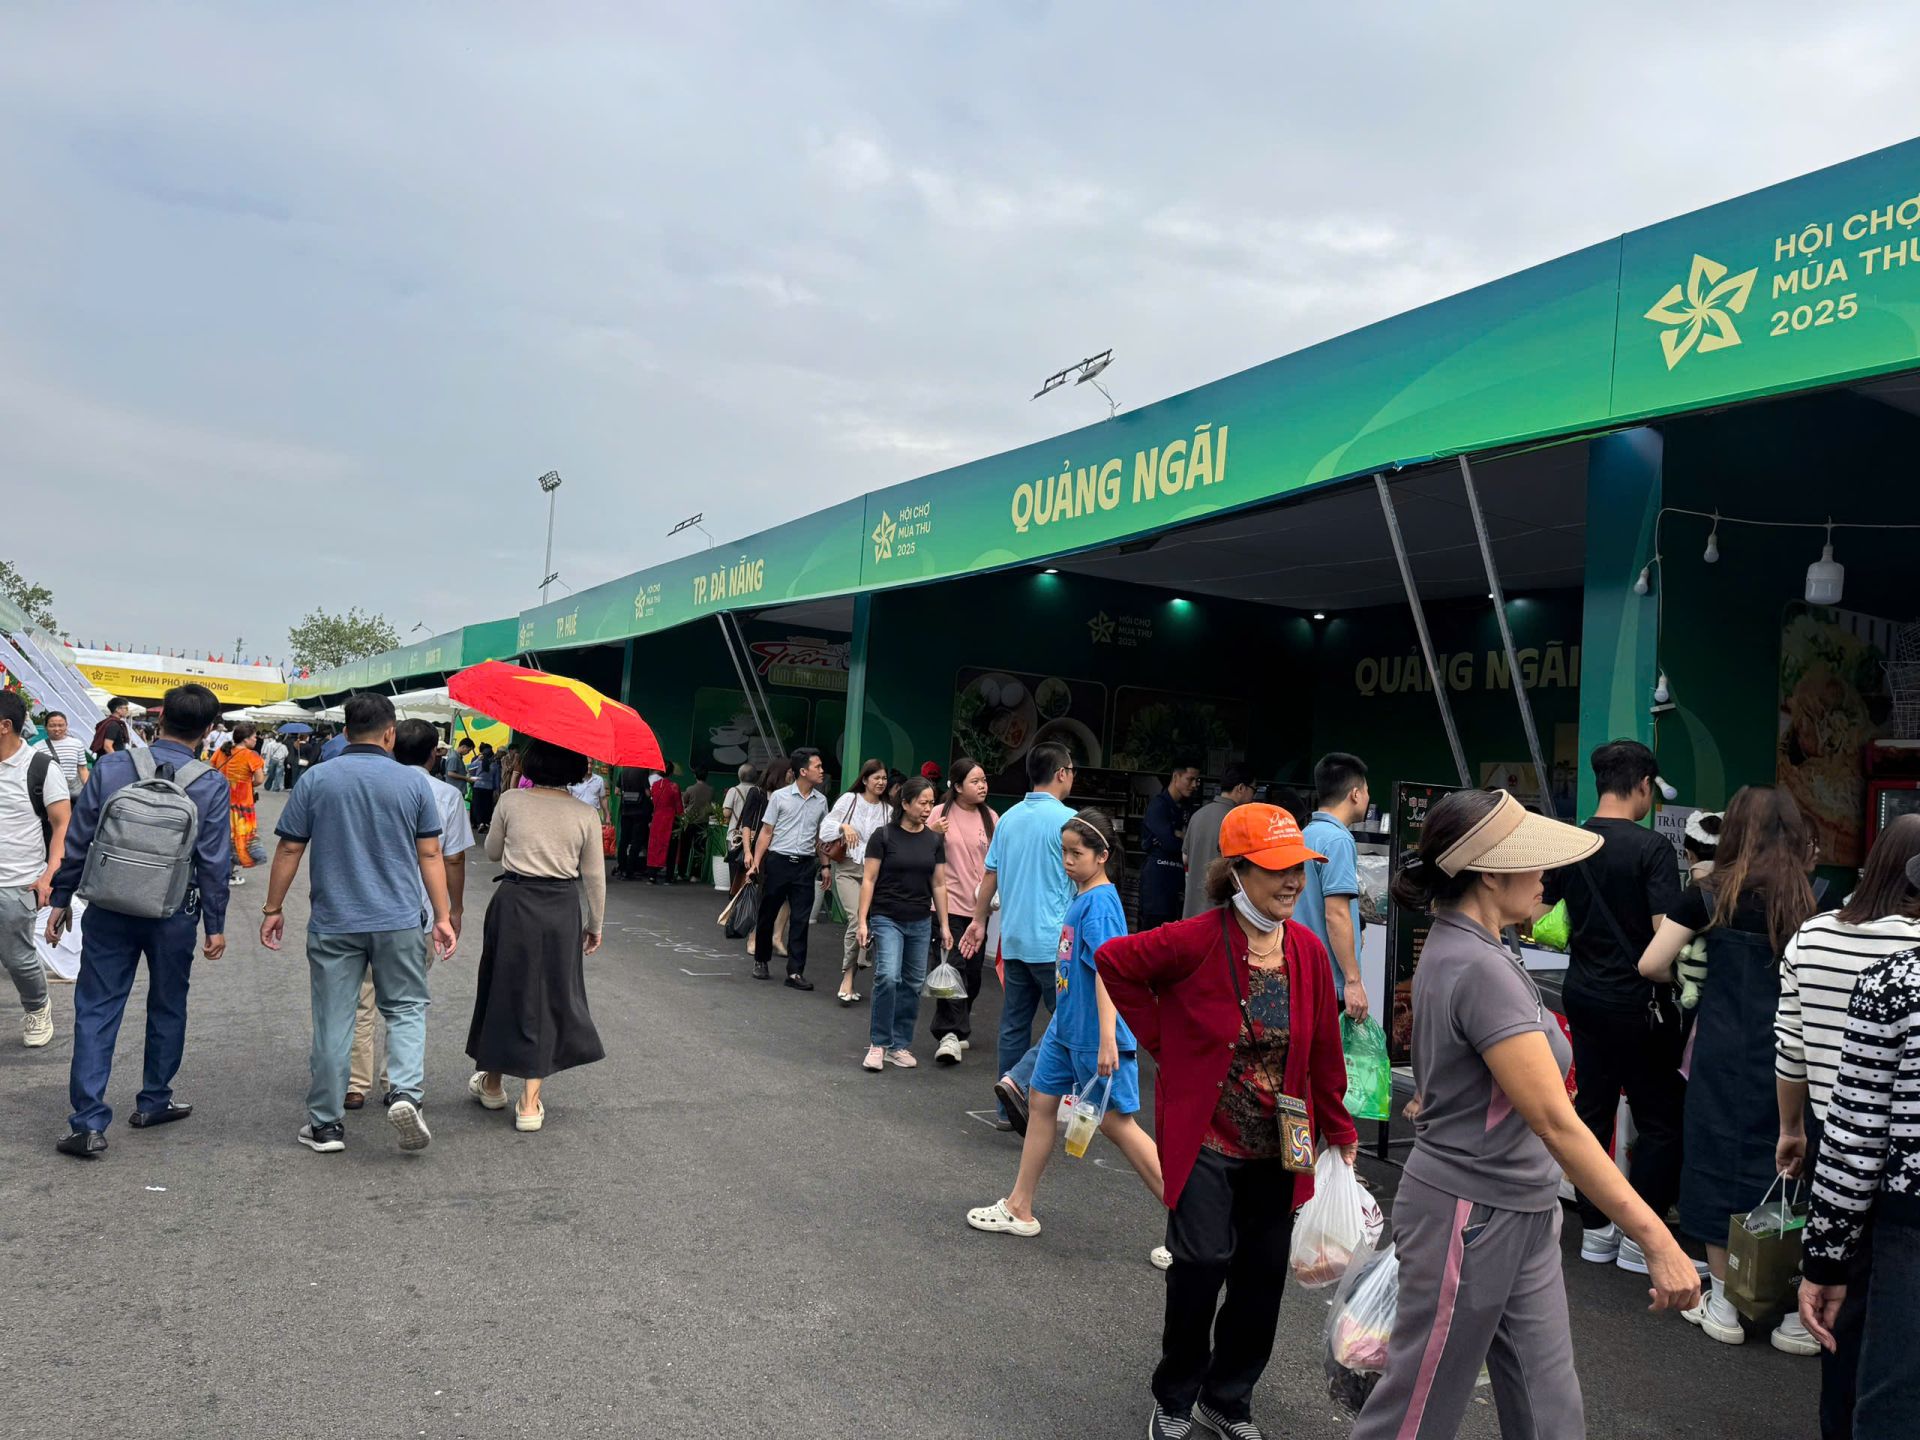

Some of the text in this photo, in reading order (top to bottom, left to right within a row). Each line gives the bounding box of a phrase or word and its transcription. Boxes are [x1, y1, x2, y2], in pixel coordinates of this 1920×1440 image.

[1774, 192, 1920, 262] HỘI CHỢ
[1772, 260, 1848, 299] MÙA
[1770, 293, 1857, 336] 2025
[1011, 422, 1228, 534] QUẢNG NGÃI
[898, 521, 931, 539] MÙA THU
[899, 501, 930, 522] HỘI CHỢ
[897, 542, 916, 557] 2025
[693, 575, 707, 606] TP.
[710, 565, 726, 602] ĐÀ
[1657, 814, 1676, 828] TRÀ
